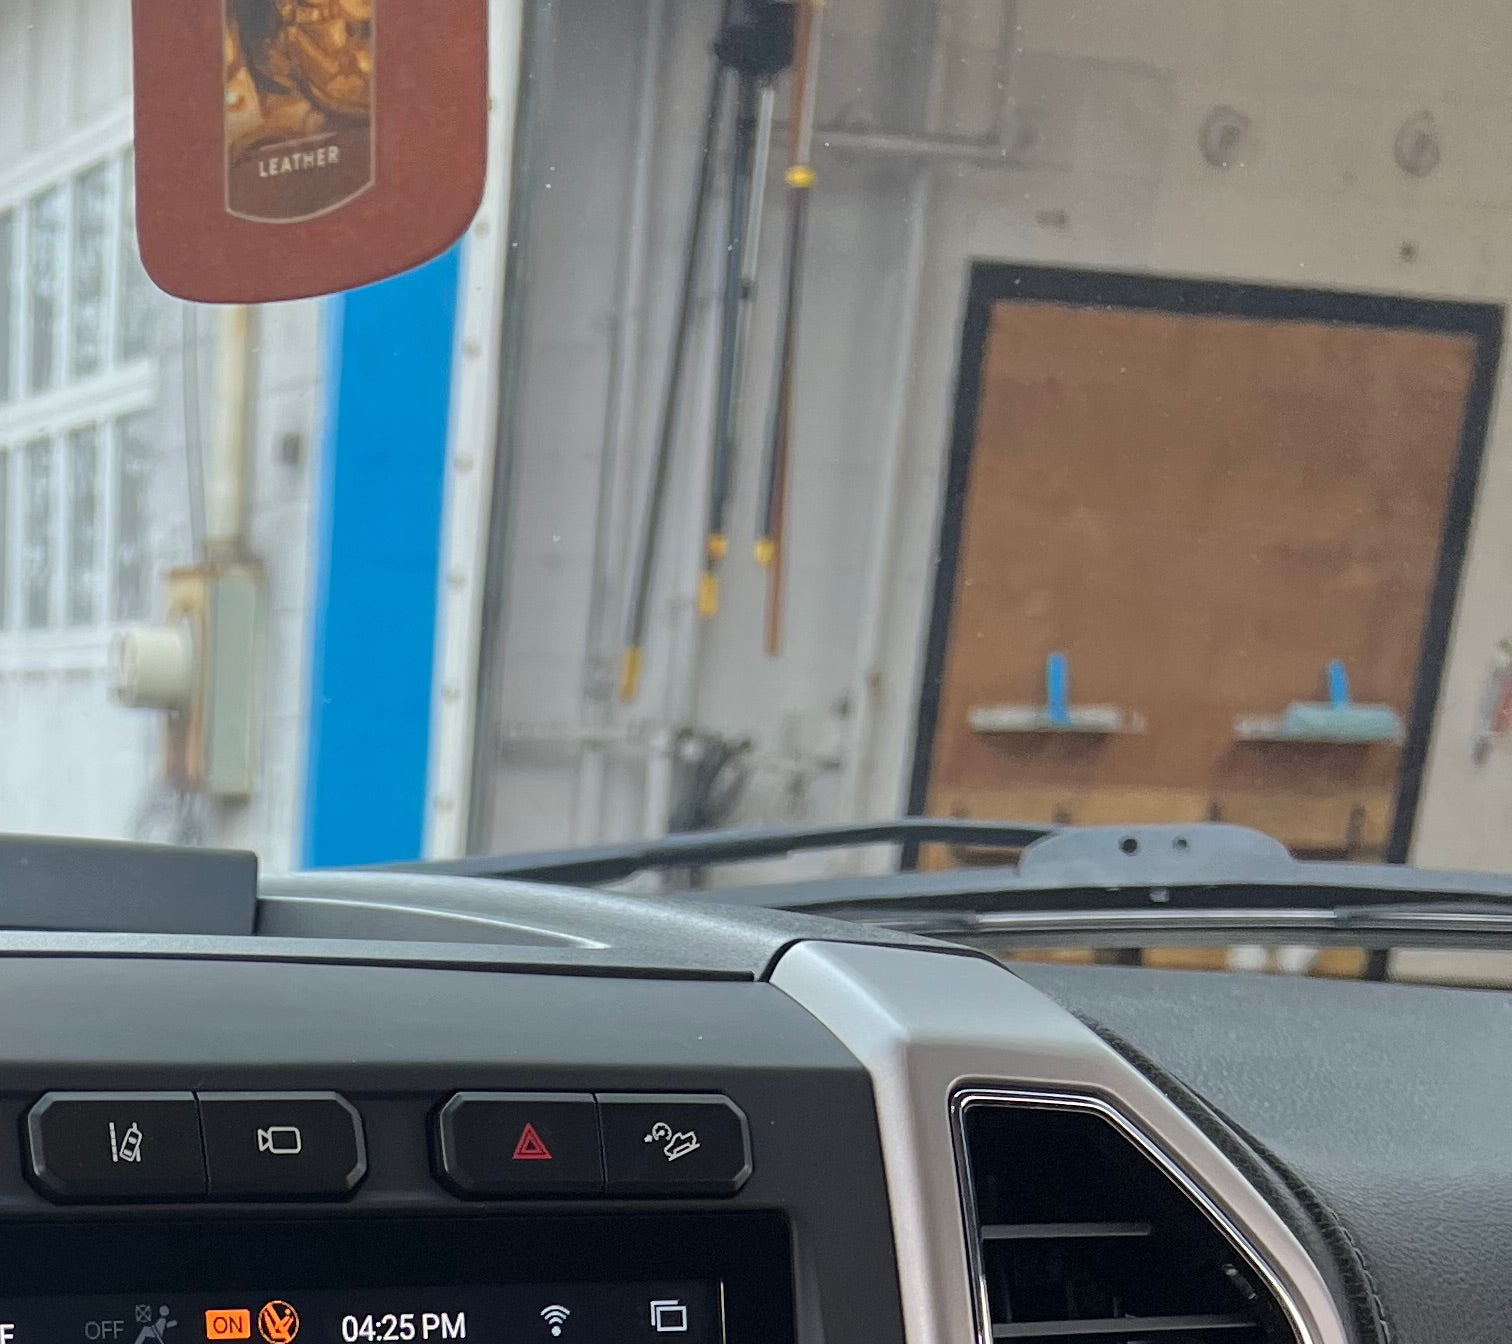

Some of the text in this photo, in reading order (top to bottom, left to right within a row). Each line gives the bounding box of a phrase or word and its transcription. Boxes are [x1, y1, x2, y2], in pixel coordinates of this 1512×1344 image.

[258, 145, 340, 178] LEATHER
[85, 1320, 124, 1341] OFF
[213, 1316, 243, 1334] ON
[341, 1311, 467, 1343] 04:25 PM
